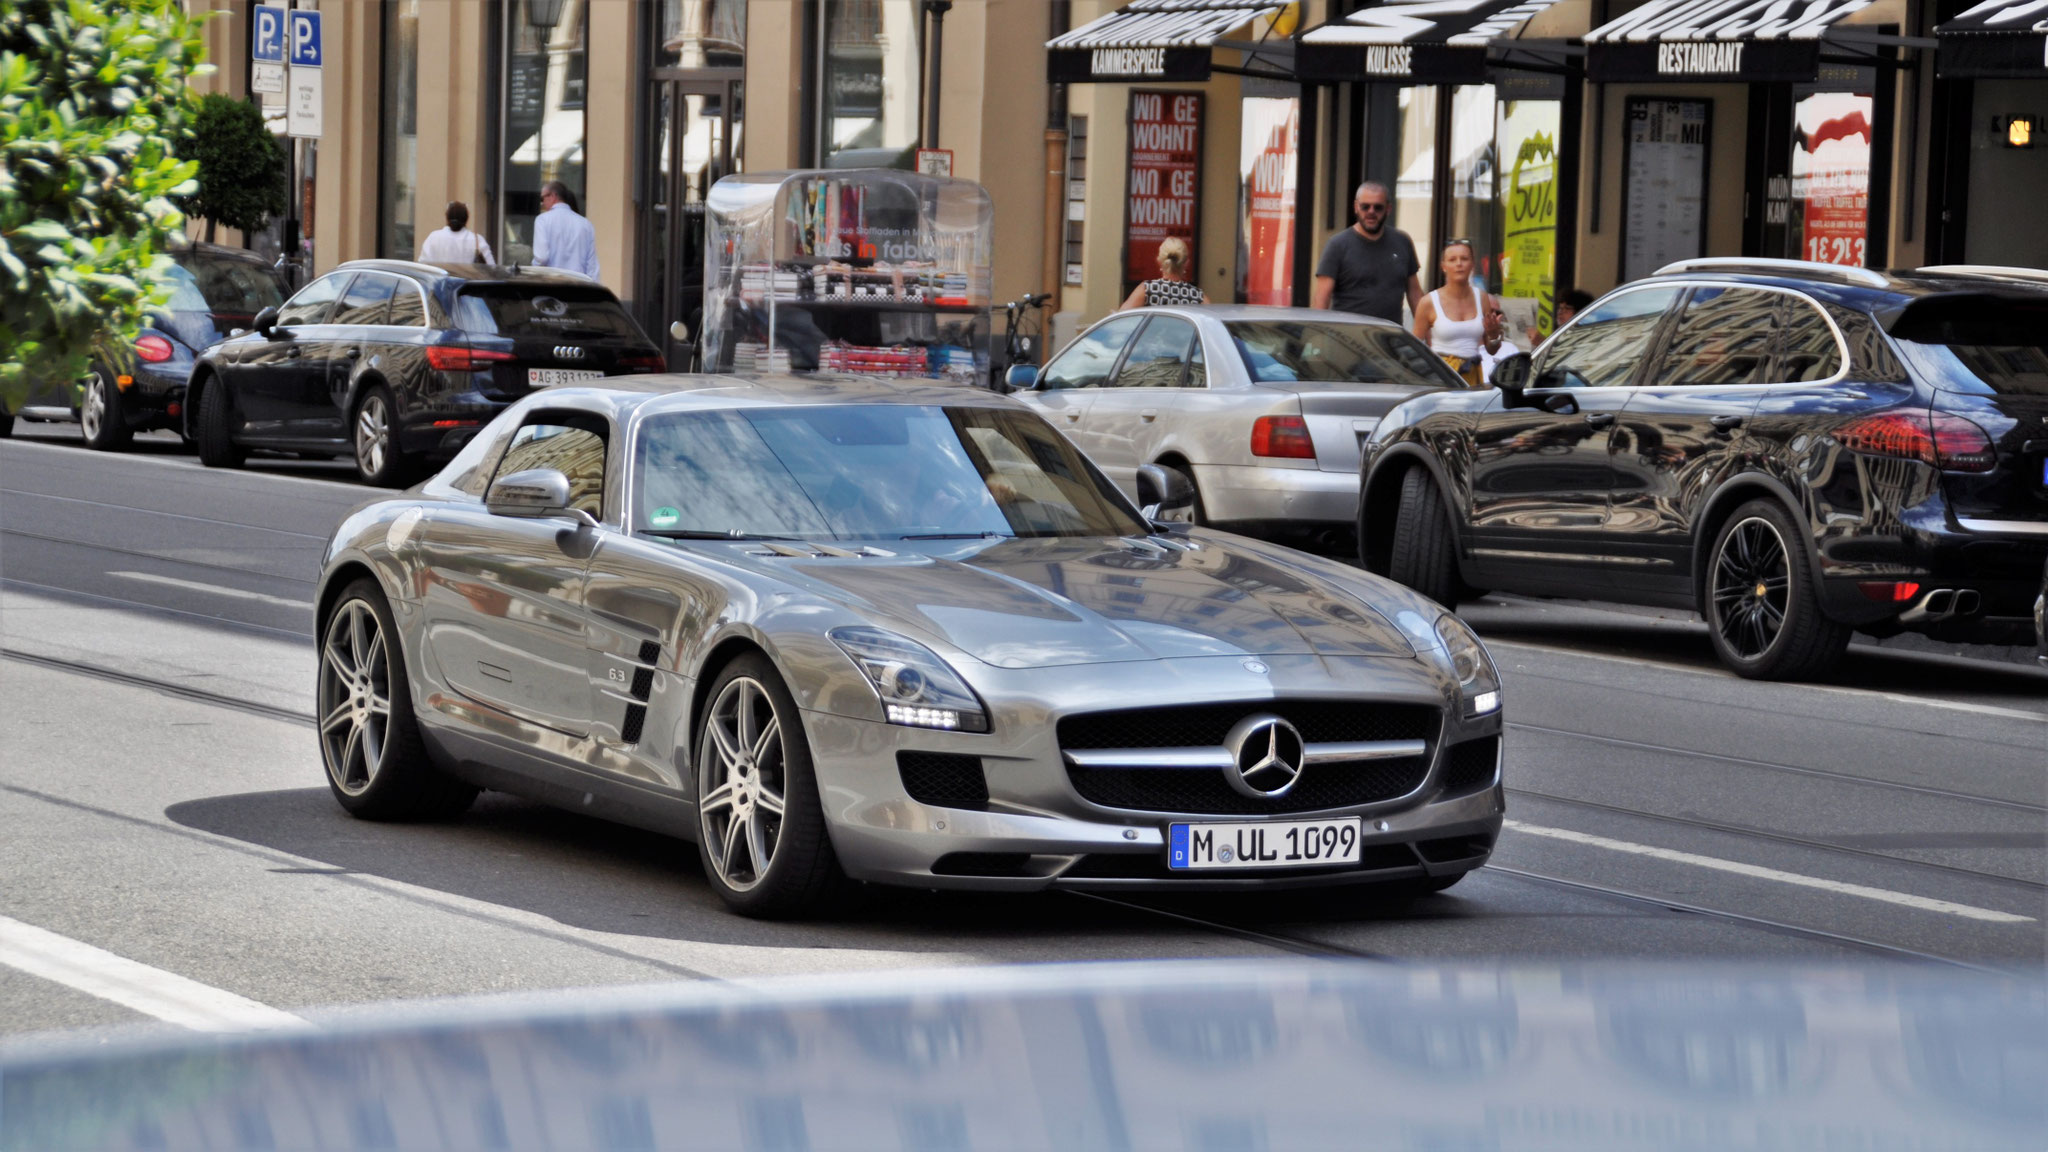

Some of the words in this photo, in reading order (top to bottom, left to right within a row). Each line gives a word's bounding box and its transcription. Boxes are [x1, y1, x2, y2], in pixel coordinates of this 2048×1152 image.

[258, 12, 276, 54] P
[295, 17, 312, 59] P
[1091, 48, 1165, 74] KAMMERSPIELE
[1366, 46, 1413, 74] KULISSE
[1658, 42, 1744, 73] RESTAURANT
[1133, 123, 1196, 151] WOHNT
[1129, 198, 1193, 225] WOHNT
[1513, 177, 1554, 223] 50%
[858, 239, 877, 259] in
[538, 370, 552, 384] AG
[1175, 850, 1183, 861] D
[1193, 829, 1213, 863] M
[1237, 828, 1277, 862] UL
[1285, 824, 1356, 861] 1099
